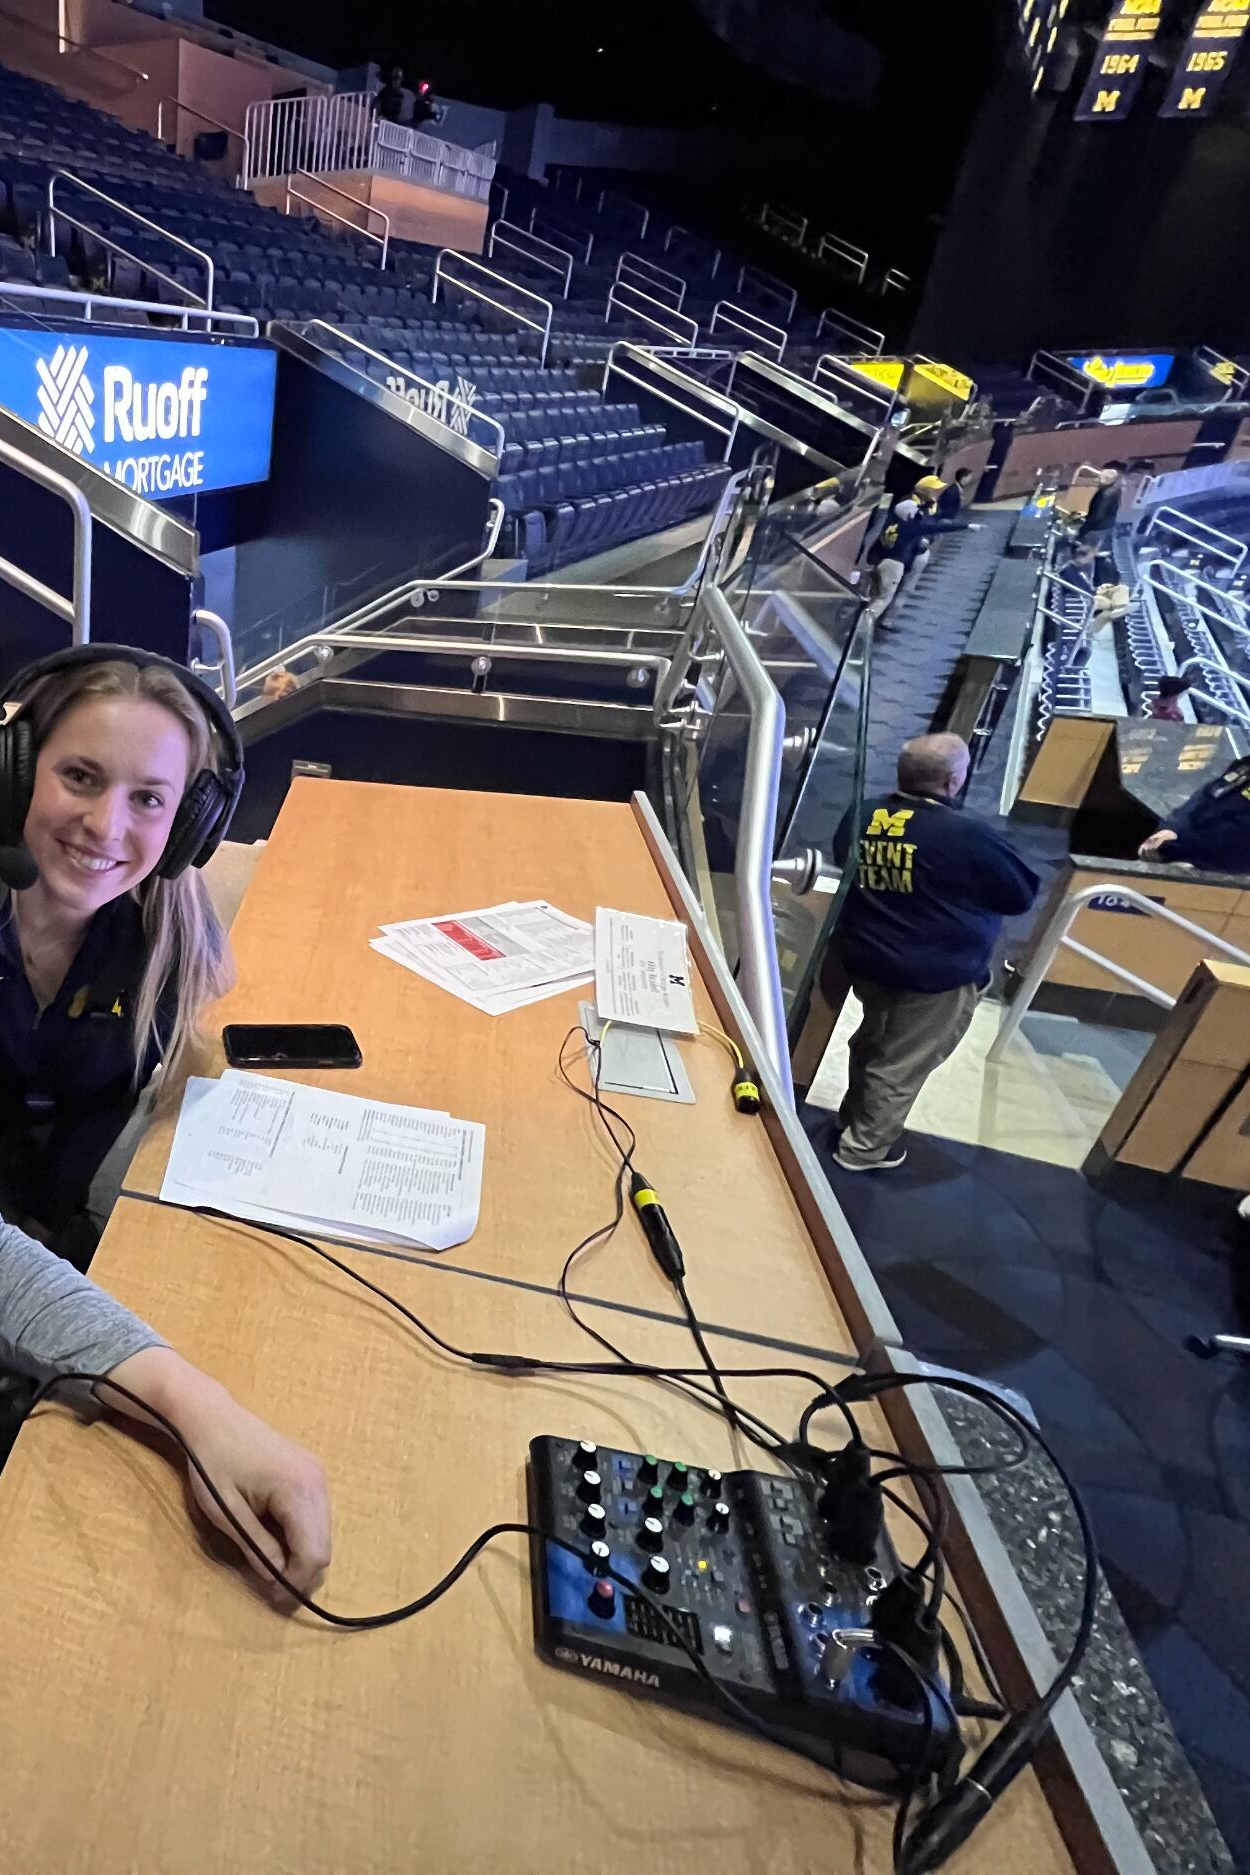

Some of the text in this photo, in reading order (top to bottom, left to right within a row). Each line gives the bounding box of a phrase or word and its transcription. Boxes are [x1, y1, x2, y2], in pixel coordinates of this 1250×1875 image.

[1100, 54, 1140, 74] 1964
[1185, 51, 1228, 72] 1965
[1092, 90, 1120, 112] M
[1178, 87, 1206, 110] M
[103, 365, 209, 443] Ruoff
[865, 808, 915, 837] M
[858, 864, 914, 893] TEAM
[579, 1652, 660, 1688] YAMAHA
